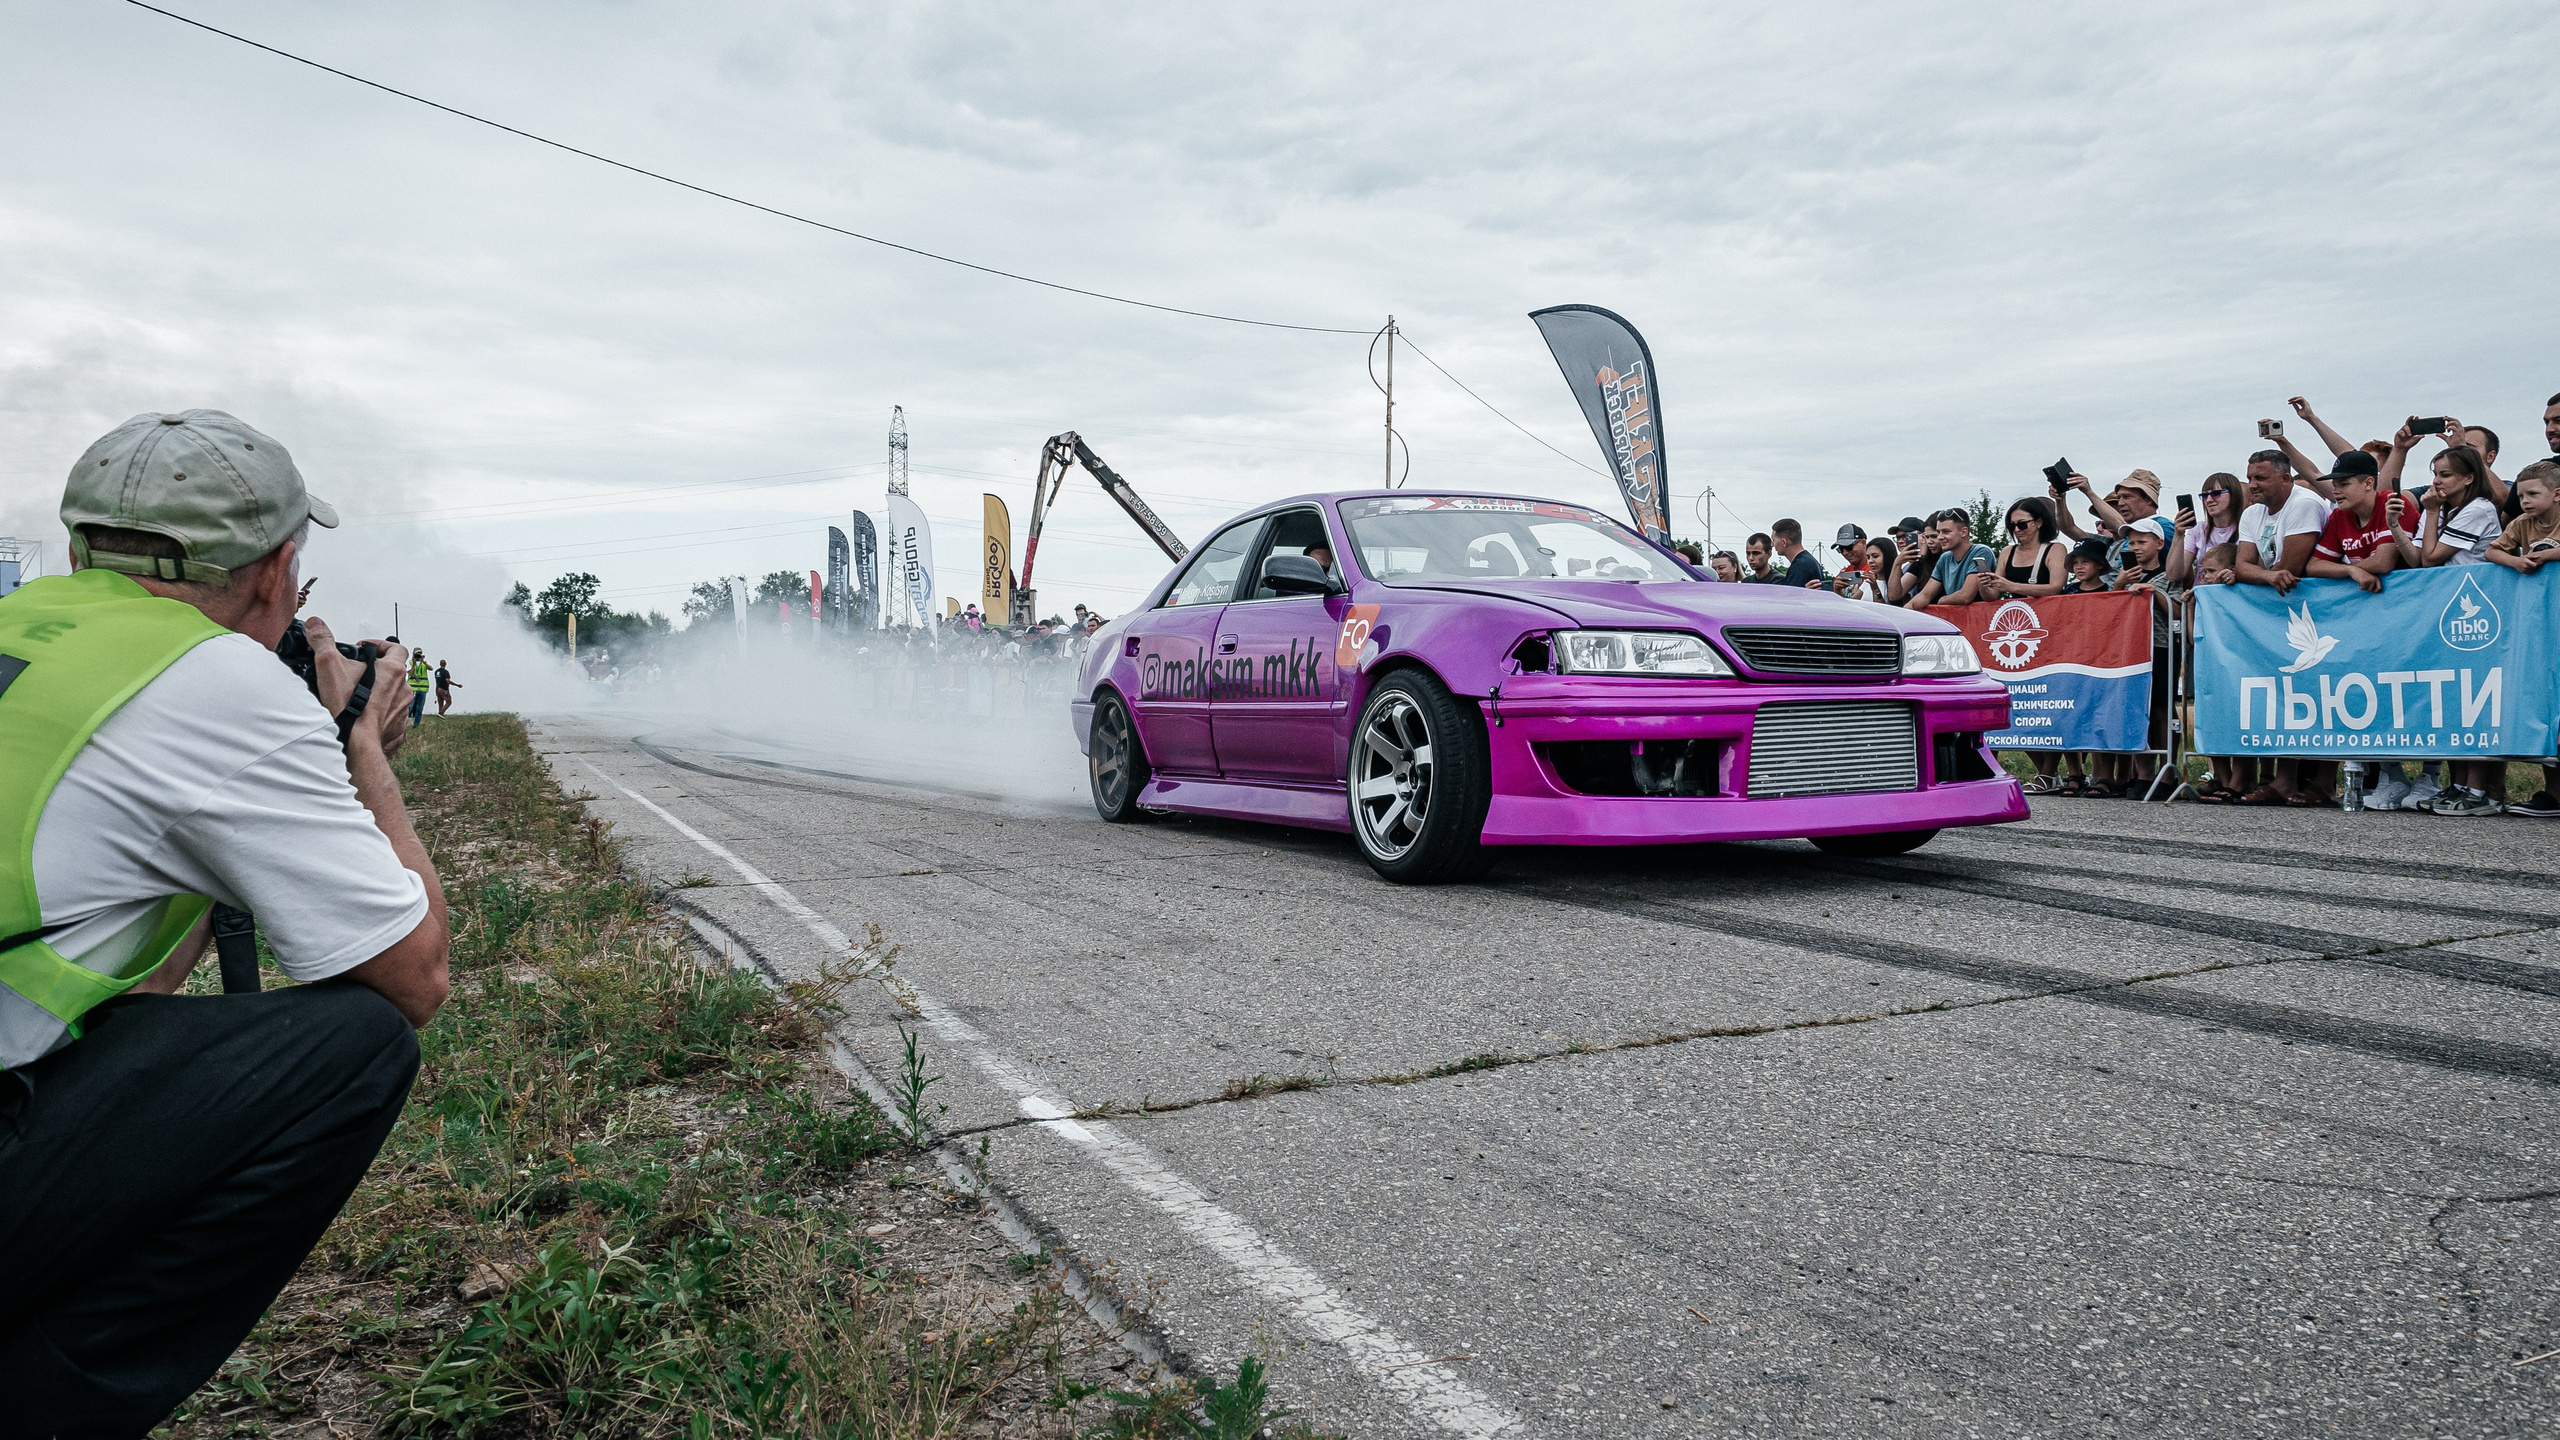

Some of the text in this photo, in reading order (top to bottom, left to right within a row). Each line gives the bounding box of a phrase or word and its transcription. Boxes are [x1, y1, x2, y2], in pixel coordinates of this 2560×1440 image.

[1135, 500, 1167, 536] 57-58-59
[2451, 618, 2489, 635] ПЬЮ
[1339, 618, 1370, 650] FQ
[2451, 633, 2490, 643] БАЛАНС
[2008, 684, 2048, 695] ЦИАЦИЯ
[2012, 699, 2075, 710] ЕХНИЧЕСКИХ
[2239, 666, 2502, 731] ПЬЮТТИ
[2015, 717, 2052, 727] СПОРТА
[1985, 734, 2063, 746] УРСКОЙ ОБЛАСТИ
[2240, 732, 2500, 749] СБАЛАНСИРОВАННАЯ ВОДА
